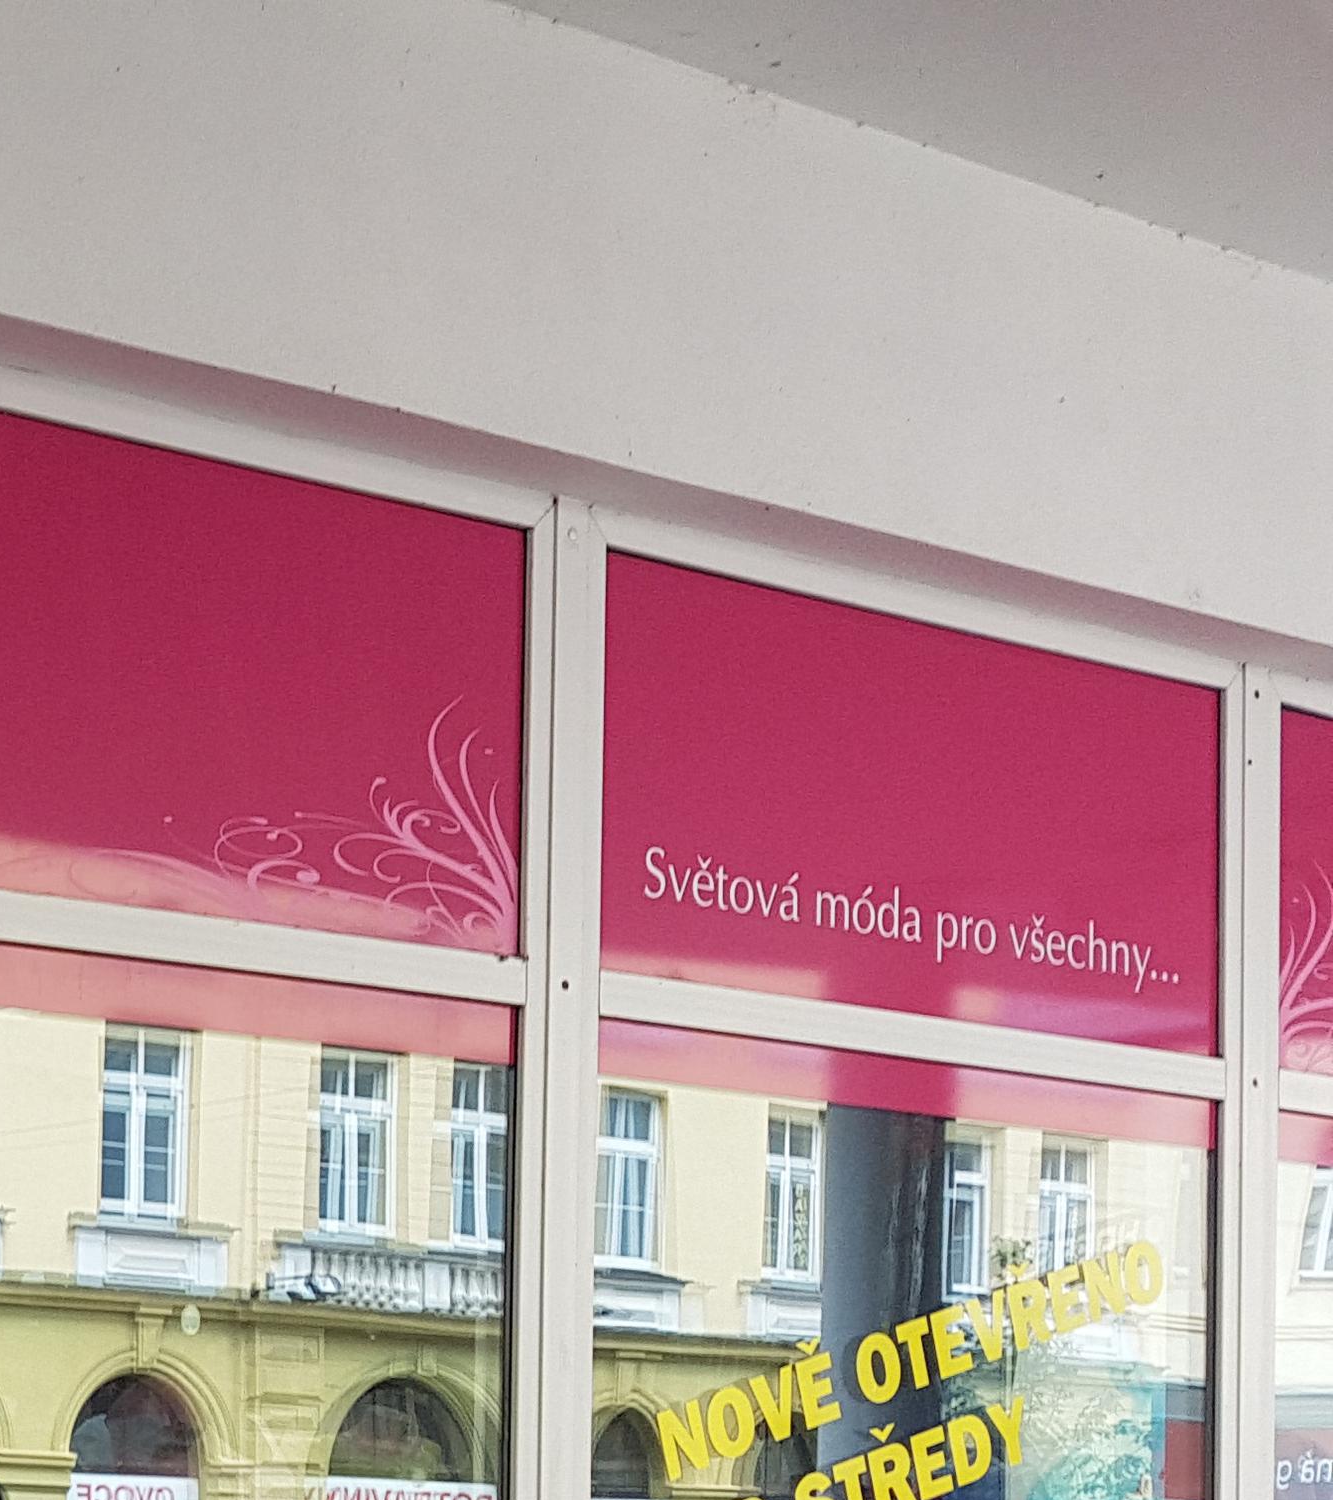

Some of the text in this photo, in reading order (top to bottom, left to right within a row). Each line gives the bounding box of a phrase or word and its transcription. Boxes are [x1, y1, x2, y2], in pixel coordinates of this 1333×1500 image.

[644, 845, 1181, 993] Světová móda pro všechny...
[655, 1239, 1164, 1483] NOVĚ OTEVŘENO
